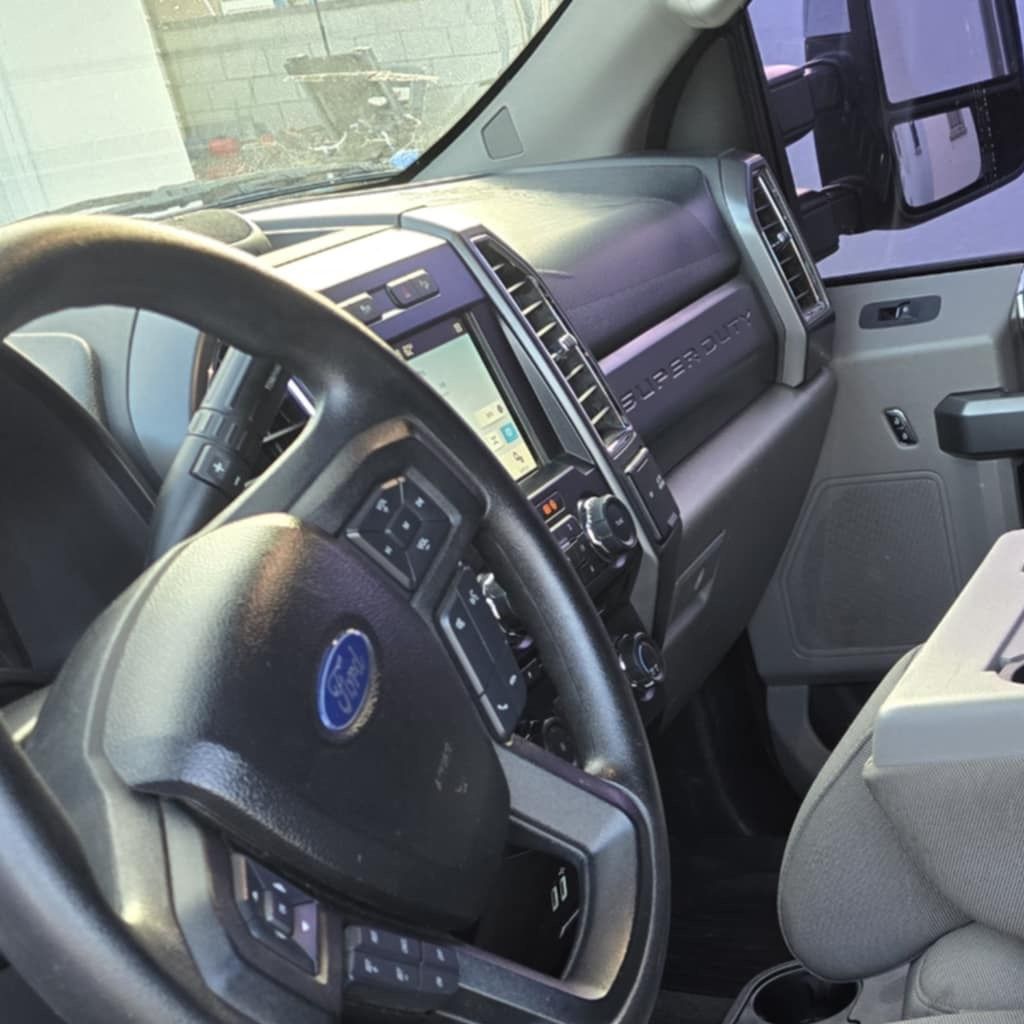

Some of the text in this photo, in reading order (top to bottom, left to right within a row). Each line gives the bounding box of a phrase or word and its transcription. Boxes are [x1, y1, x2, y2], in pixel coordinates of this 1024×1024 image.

[620, 310, 752, 413] SUPER DUTY
[328, 644, 366, 714] Ford
